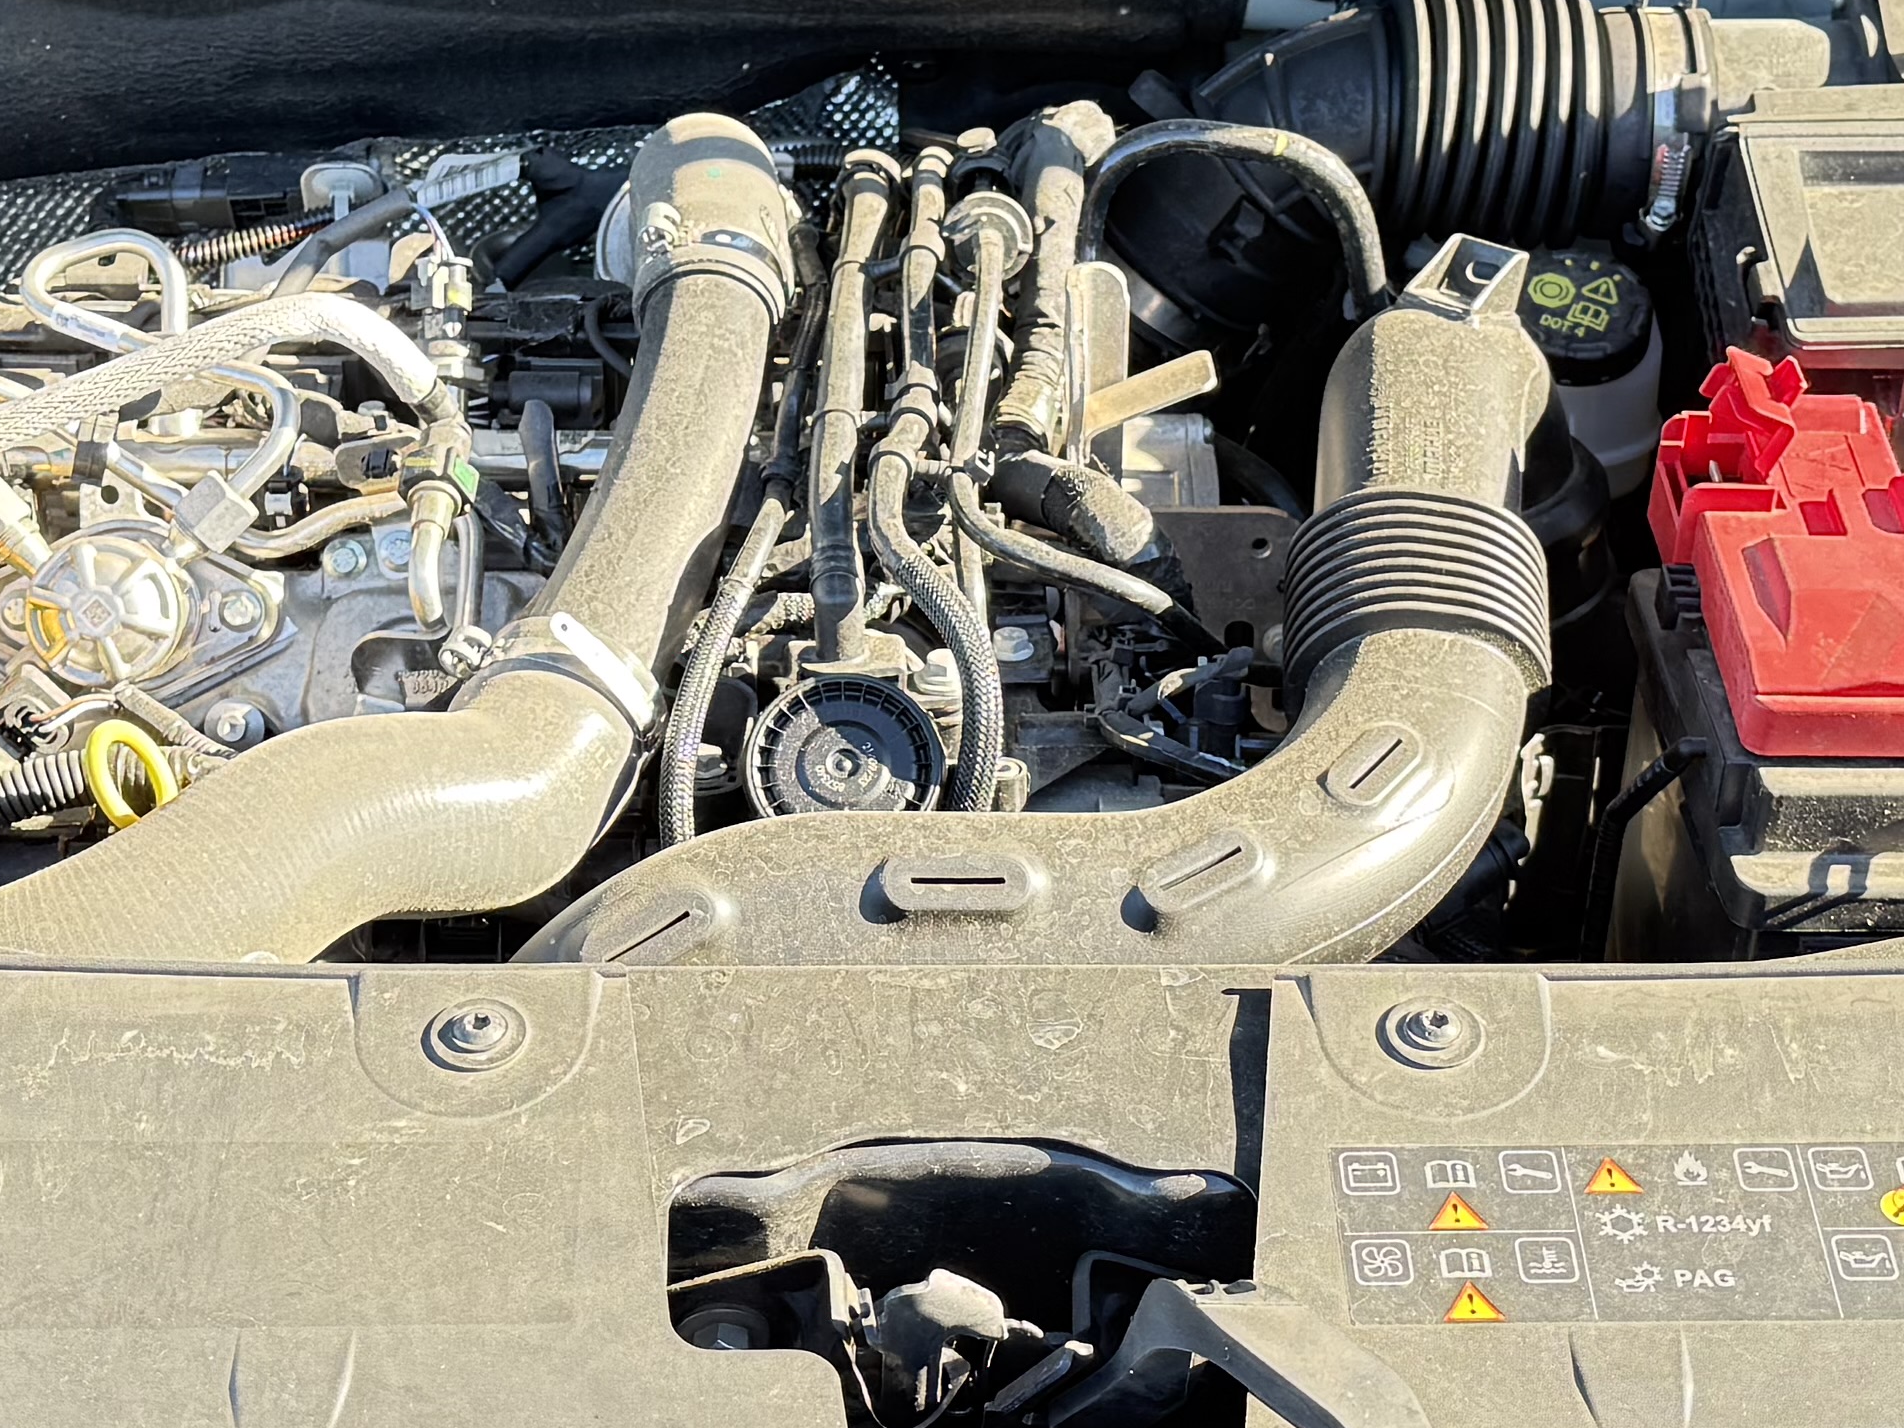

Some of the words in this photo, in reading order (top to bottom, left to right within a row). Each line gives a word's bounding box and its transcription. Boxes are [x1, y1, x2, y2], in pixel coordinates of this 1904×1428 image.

[1539, 313, 1574, 333] DOT
[1574, 325, 1586, 338] 4
[1655, 1214, 1773, 1237] R-1234yf
[1673, 1268, 1737, 1288] PAG
